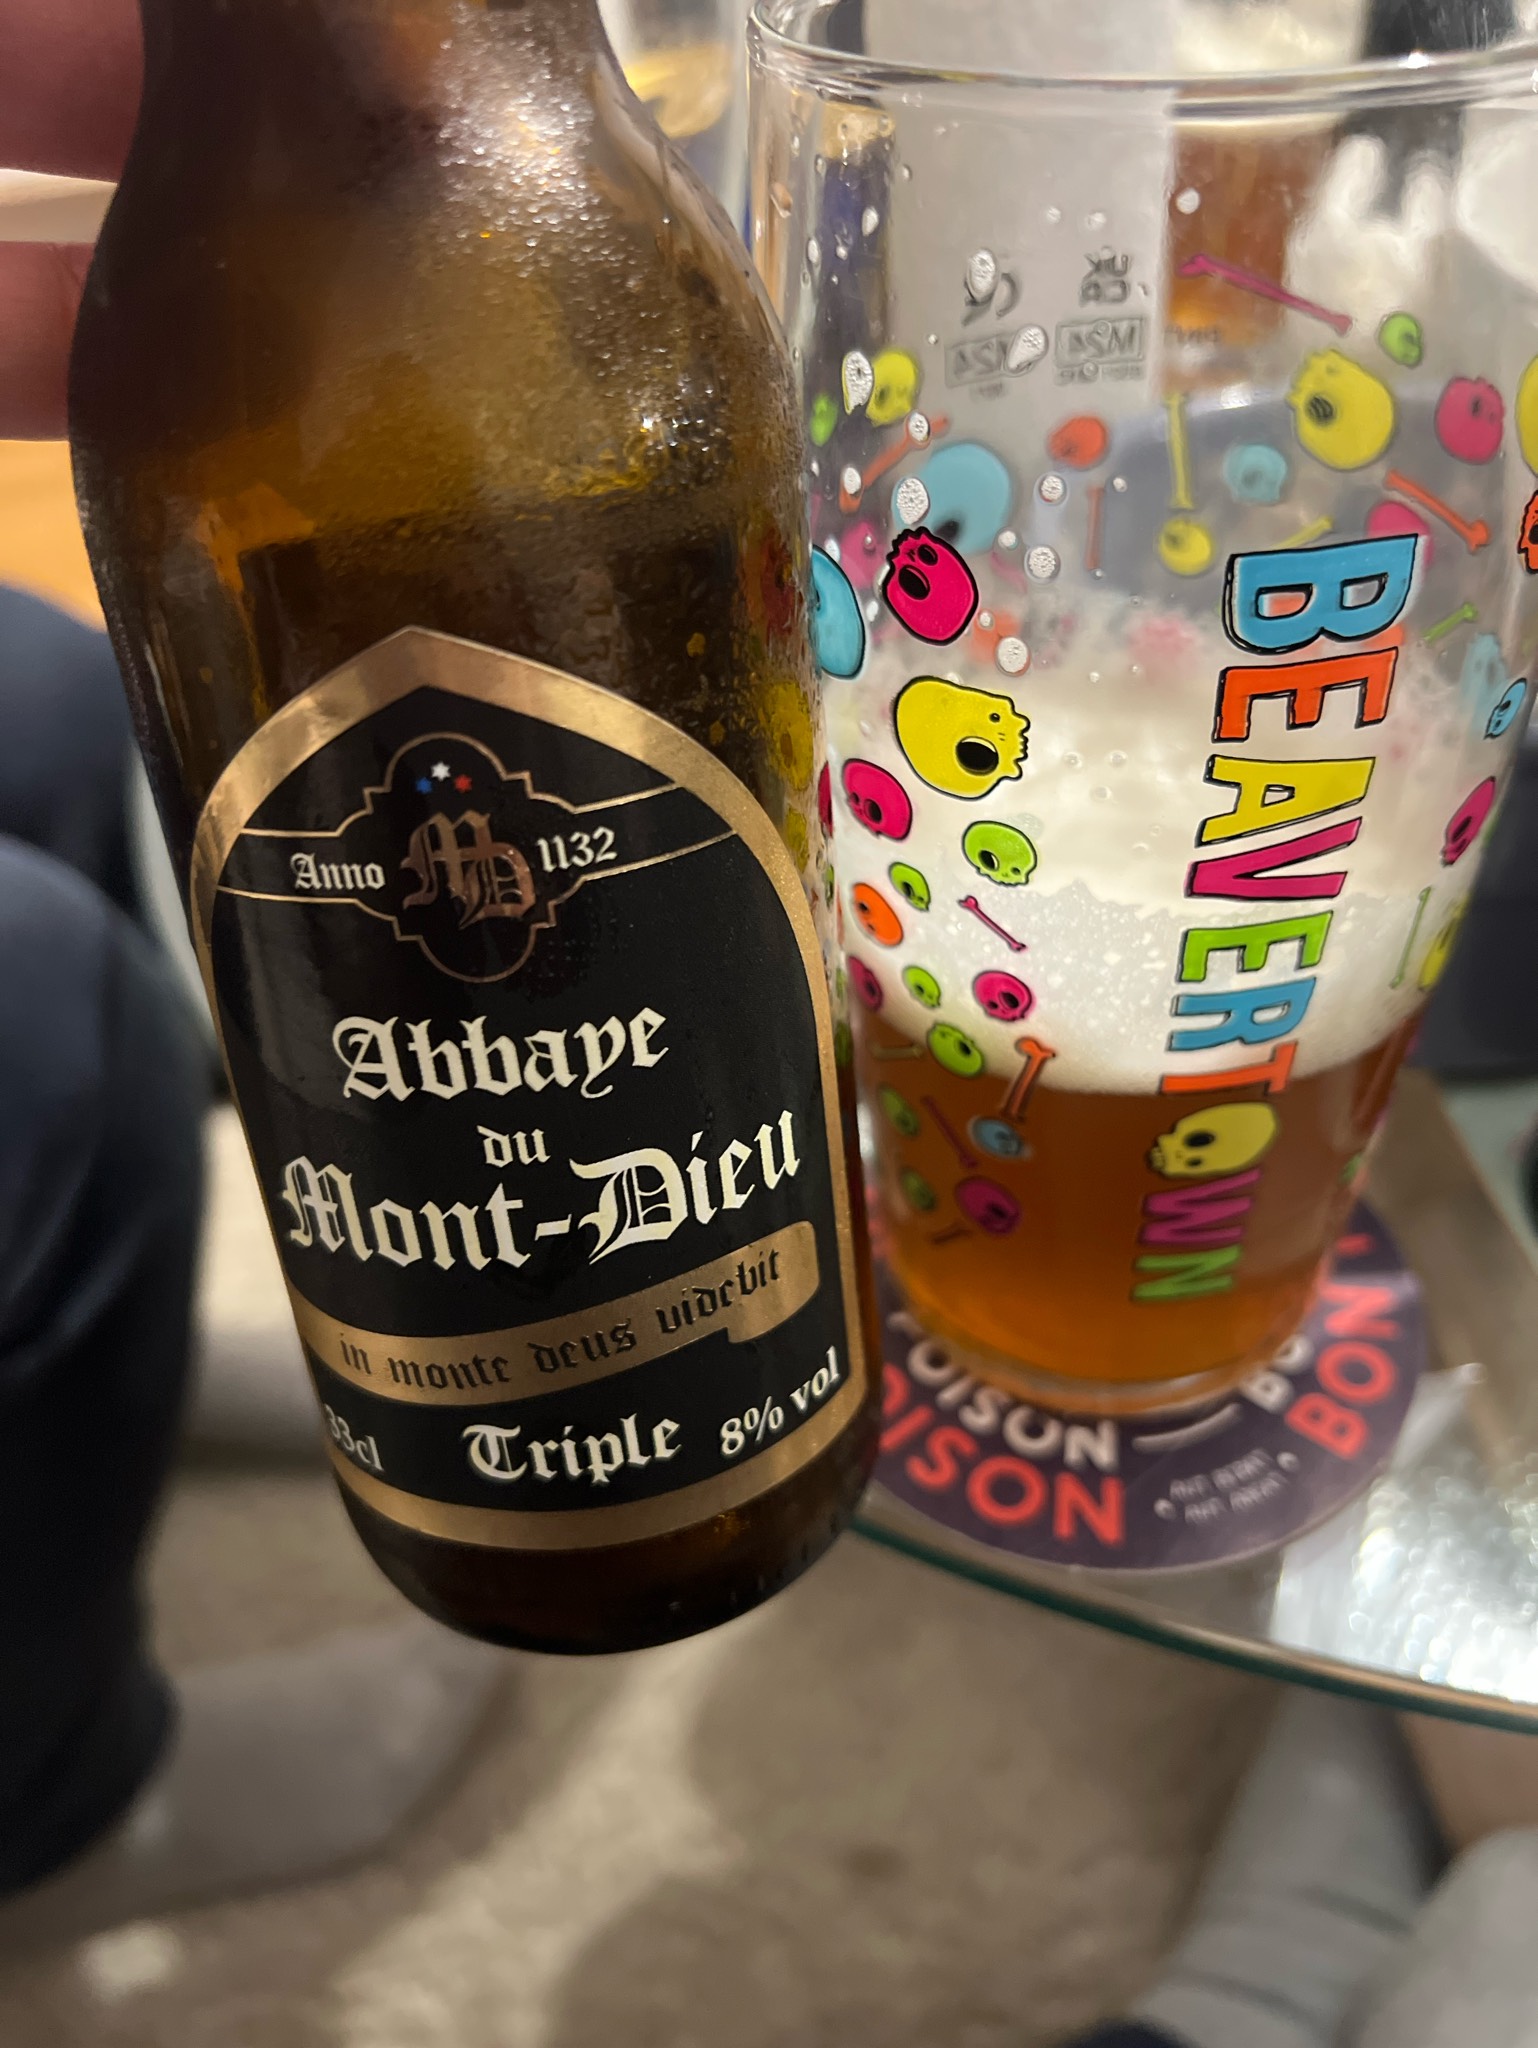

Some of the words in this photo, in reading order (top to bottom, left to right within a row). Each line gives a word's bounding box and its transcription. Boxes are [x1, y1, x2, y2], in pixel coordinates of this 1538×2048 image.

[289, 853, 386, 892] Anno
[536, 827, 617, 873] 1132
[1131, 533, 1420, 1302] BEAVERTOWN
[332, 1006, 669, 1101] Abbaye
[281, 1109, 801, 1272] Mont-Dieu
[476, 1124, 551, 1169] du
[340, 1332, 371, 1375] in
[386, 1353, 512, 1390] monte
[527, 1317, 638, 1374] deus
[655, 1248, 780, 1334] videbit
[322, 1402, 384, 1472] 33cl
[461, 1411, 683, 1486] Triple
[719, 1396, 785, 1457] 8%
[788, 1345, 842, 1413] vol
[878, 1362, 1130, 1547] ISON
[1284, 1283, 1398, 1460] BON
